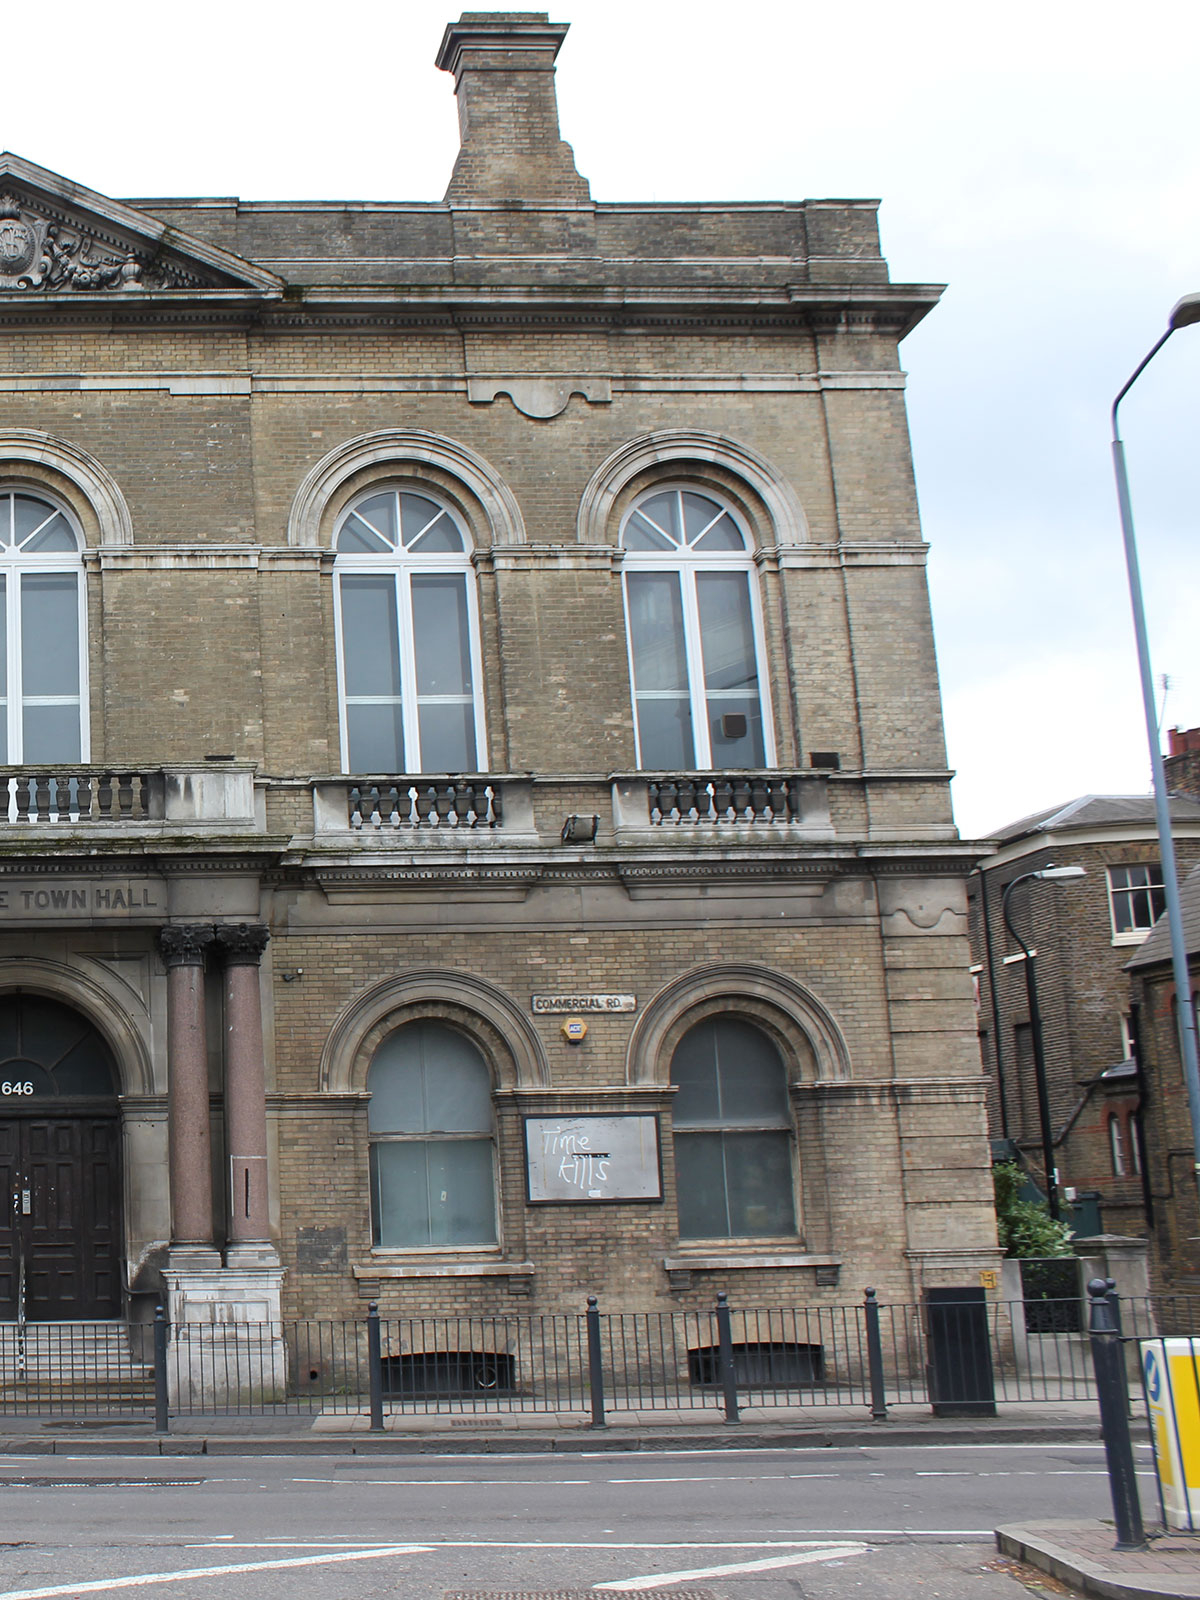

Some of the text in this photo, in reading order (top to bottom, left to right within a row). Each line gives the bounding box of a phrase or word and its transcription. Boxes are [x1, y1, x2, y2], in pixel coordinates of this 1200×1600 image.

[20, 889, 86, 910] TOWN
[96, 888, 157, 909] HALL
[535, 998, 602, 1009] COMMERCIAL
[1, 1081, 34, 1096] 646
